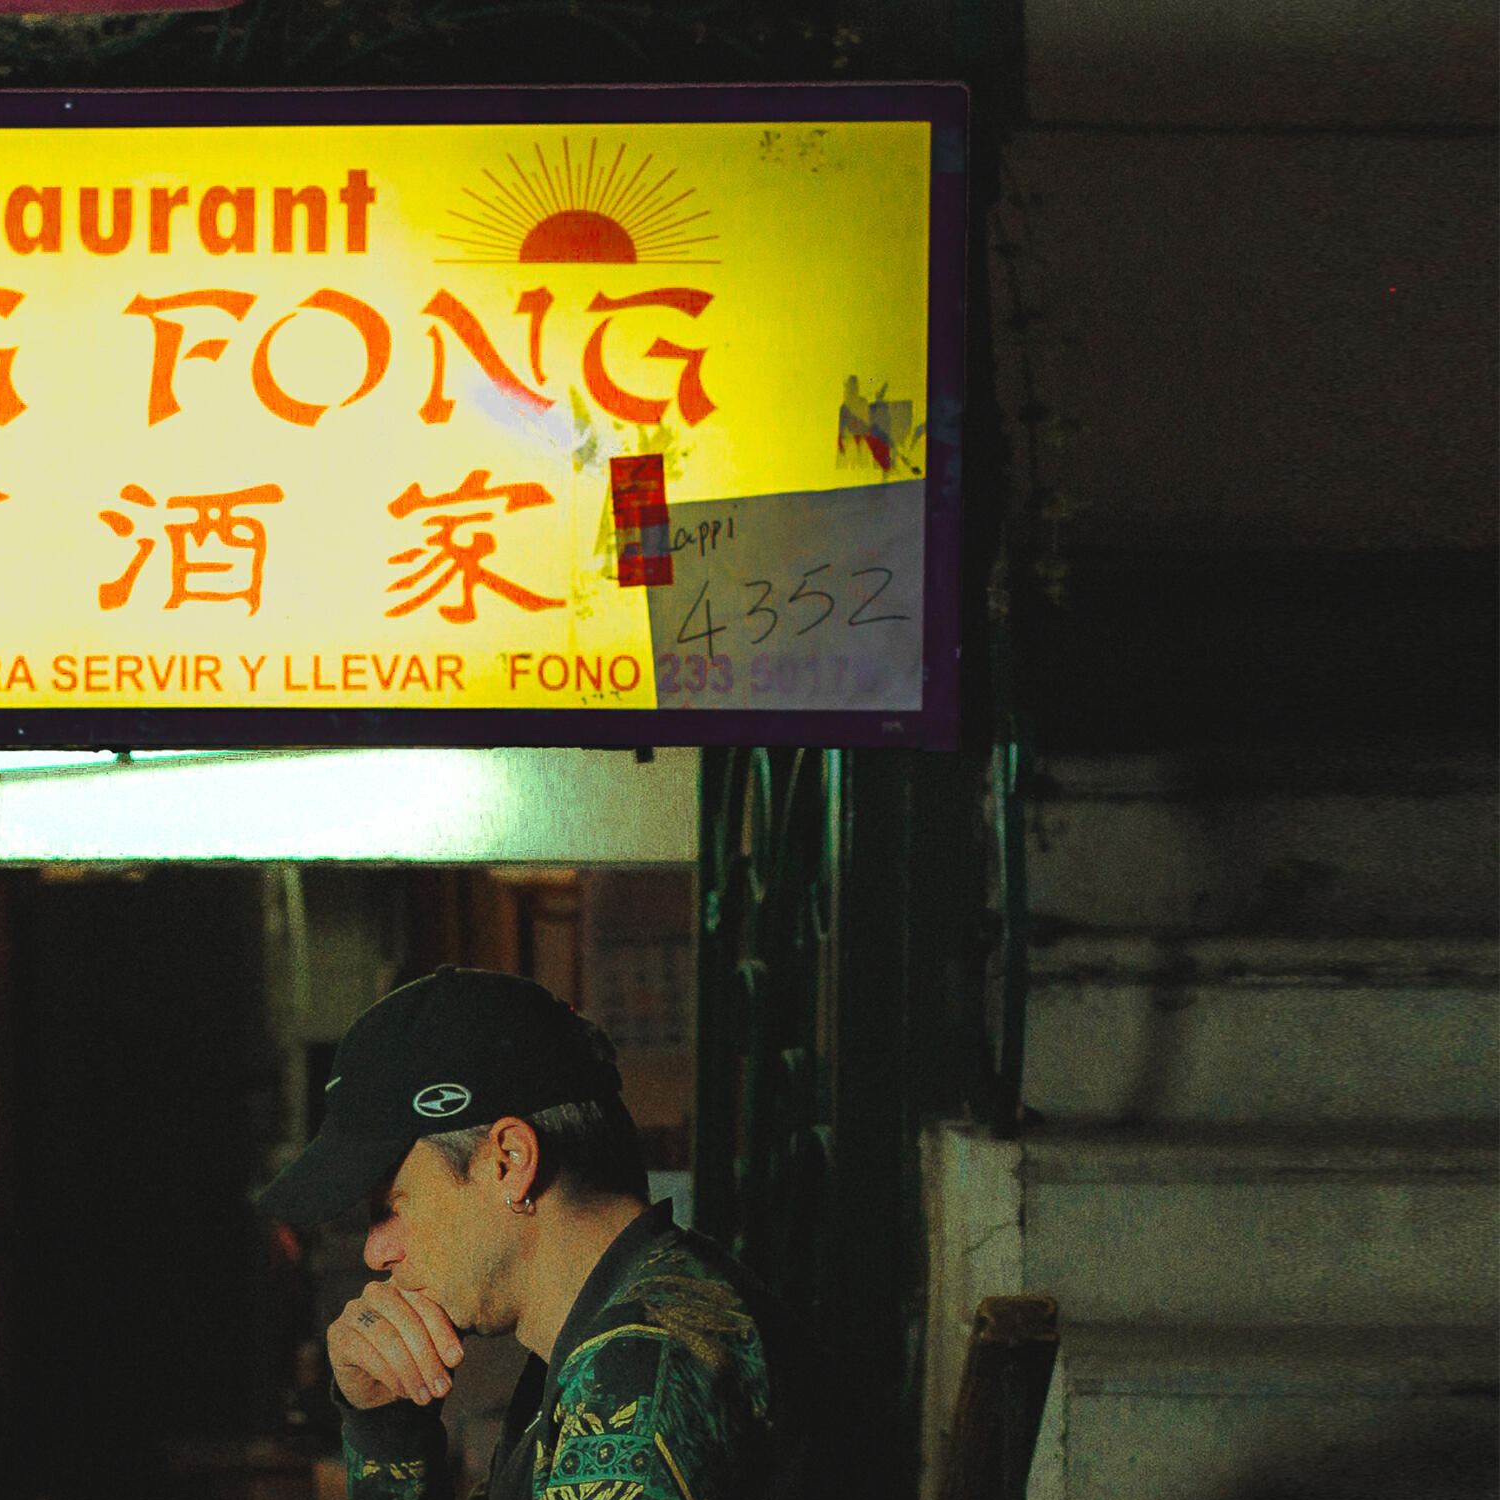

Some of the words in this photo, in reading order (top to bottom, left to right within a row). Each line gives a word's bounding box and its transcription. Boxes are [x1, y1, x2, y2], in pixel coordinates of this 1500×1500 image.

[124, 286, 717, 427] FONG
[658, 508, 737, 556] appi
[677, 564, 911, 659] 4352
[53, 655, 220, 692] SERVIR
[241, 655, 265, 692] Y
[285, 655, 463, 692] LLEVAR
[510, 654, 640, 692] FONO
[659, 653, 733, 693] 233
